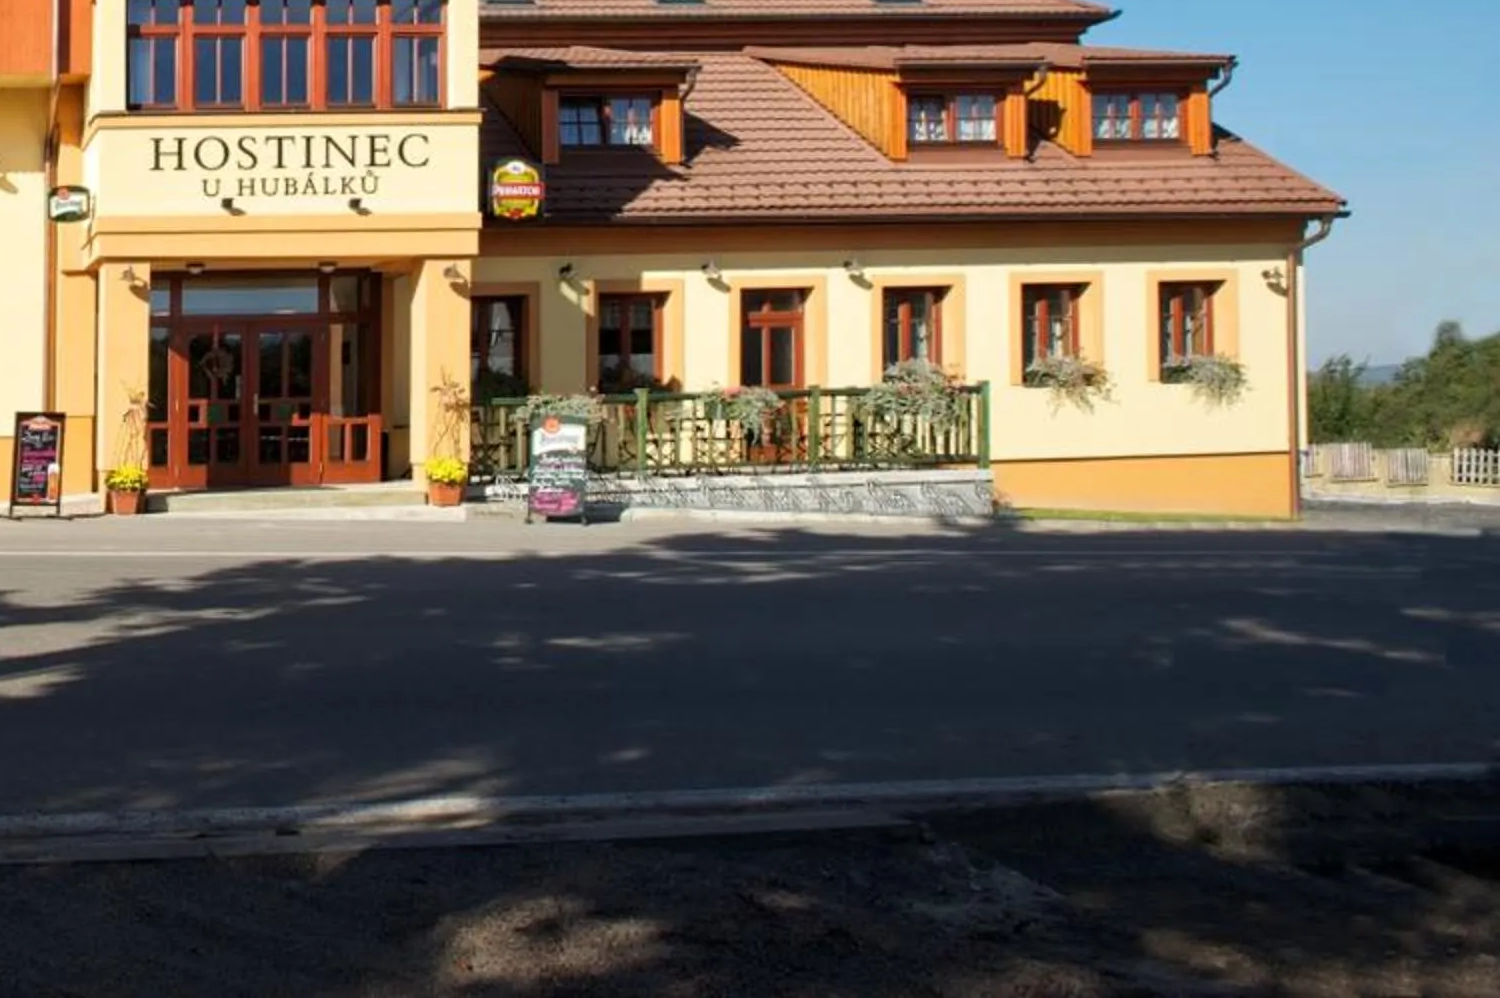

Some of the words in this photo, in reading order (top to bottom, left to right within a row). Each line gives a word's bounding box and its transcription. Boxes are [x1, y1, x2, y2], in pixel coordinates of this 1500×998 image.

[149, 133, 430, 171] HOSTINEC
[201, 178, 221, 197] U
[237, 169, 380, 197] HUBÁLKŮ
